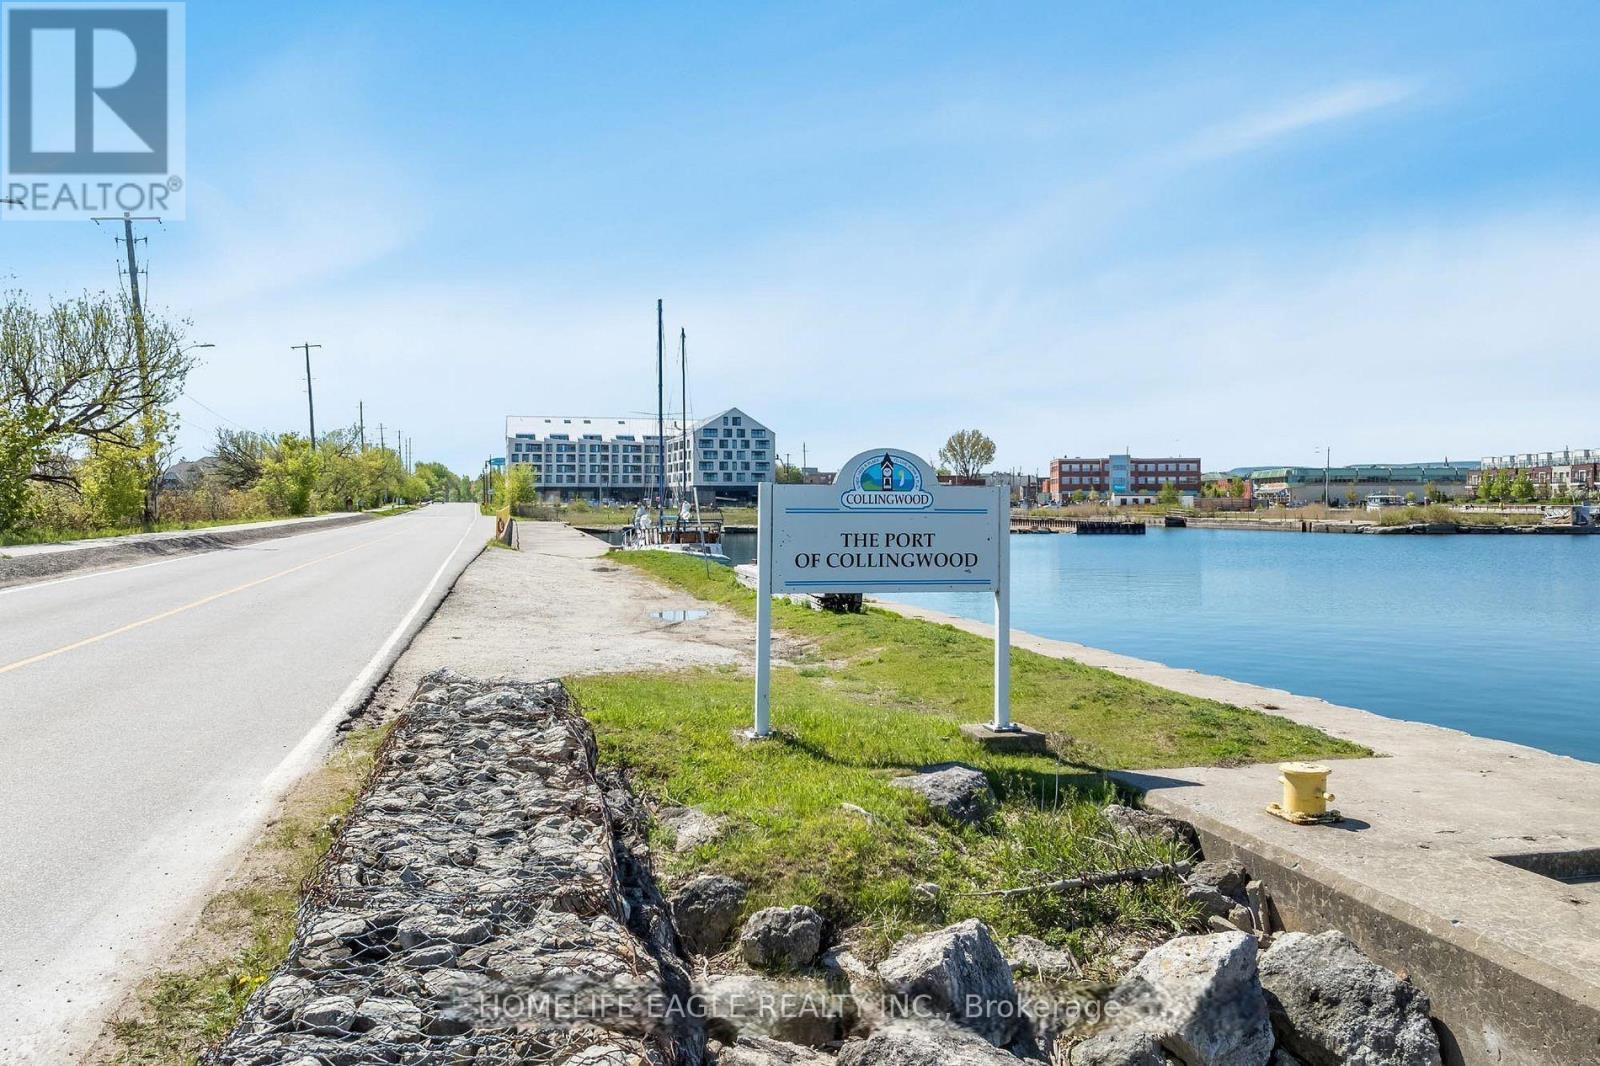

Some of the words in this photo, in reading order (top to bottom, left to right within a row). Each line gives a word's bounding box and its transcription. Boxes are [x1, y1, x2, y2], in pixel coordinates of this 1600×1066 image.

[846, 493, 929, 505] COLLINGWOOD
[840, 532, 880, 548] THE
[885, 532, 936, 548] PORT
[794, 552, 821, 569] OF
[826, 552, 979, 568] COLLINGWOOD
